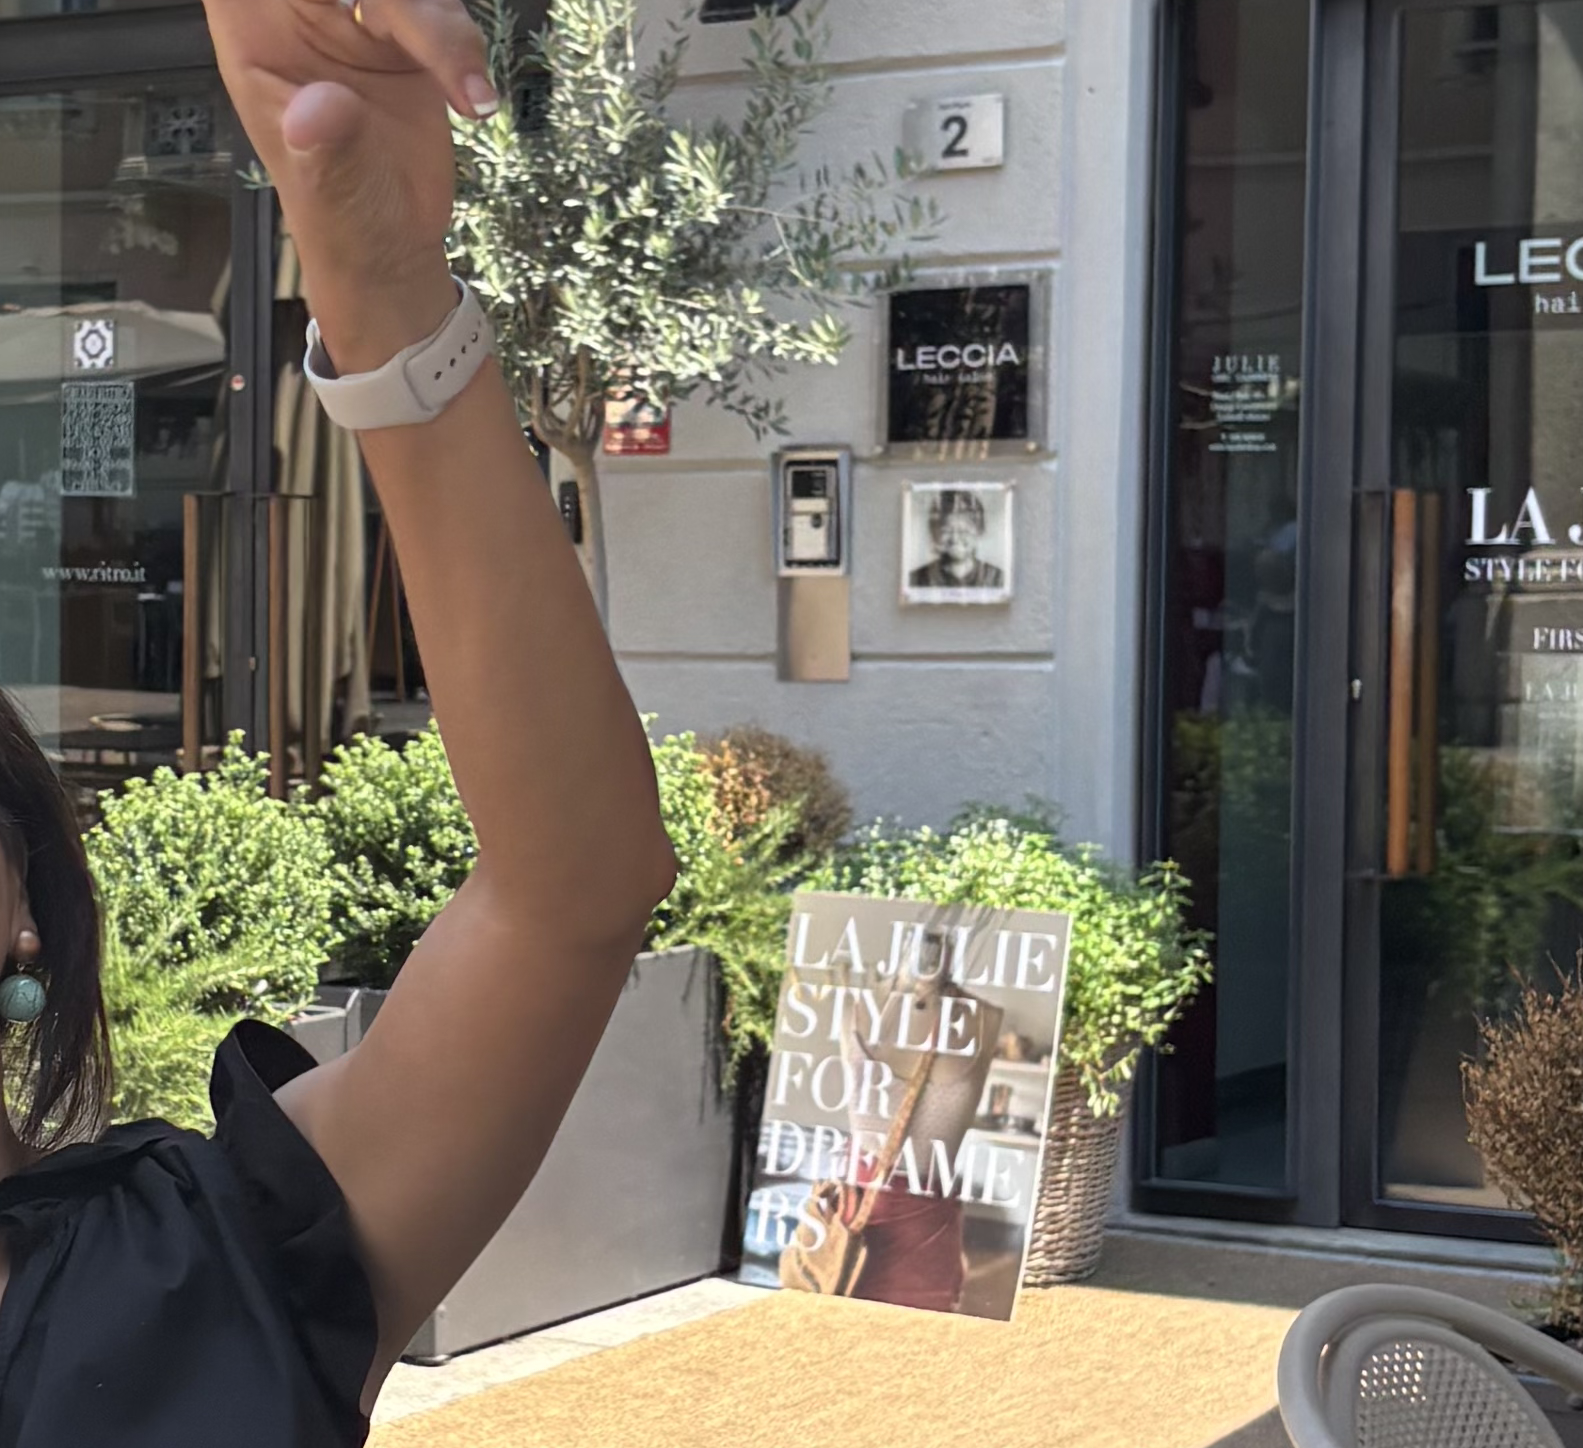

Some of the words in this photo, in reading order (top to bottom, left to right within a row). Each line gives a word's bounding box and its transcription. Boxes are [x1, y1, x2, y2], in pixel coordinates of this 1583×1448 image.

[941, 114, 968, 159] 2
[896, 341, 1019, 371] LECCIA
[1464, 486, 1556, 546] LA
[1464, 556, 1551, 582] STYLE
[793, 912, 867, 974] LA
[876, 920, 1058, 993] JULIE
[780, 983, 979, 1058] STYLE
[771, 1050, 894, 1120] FOR
